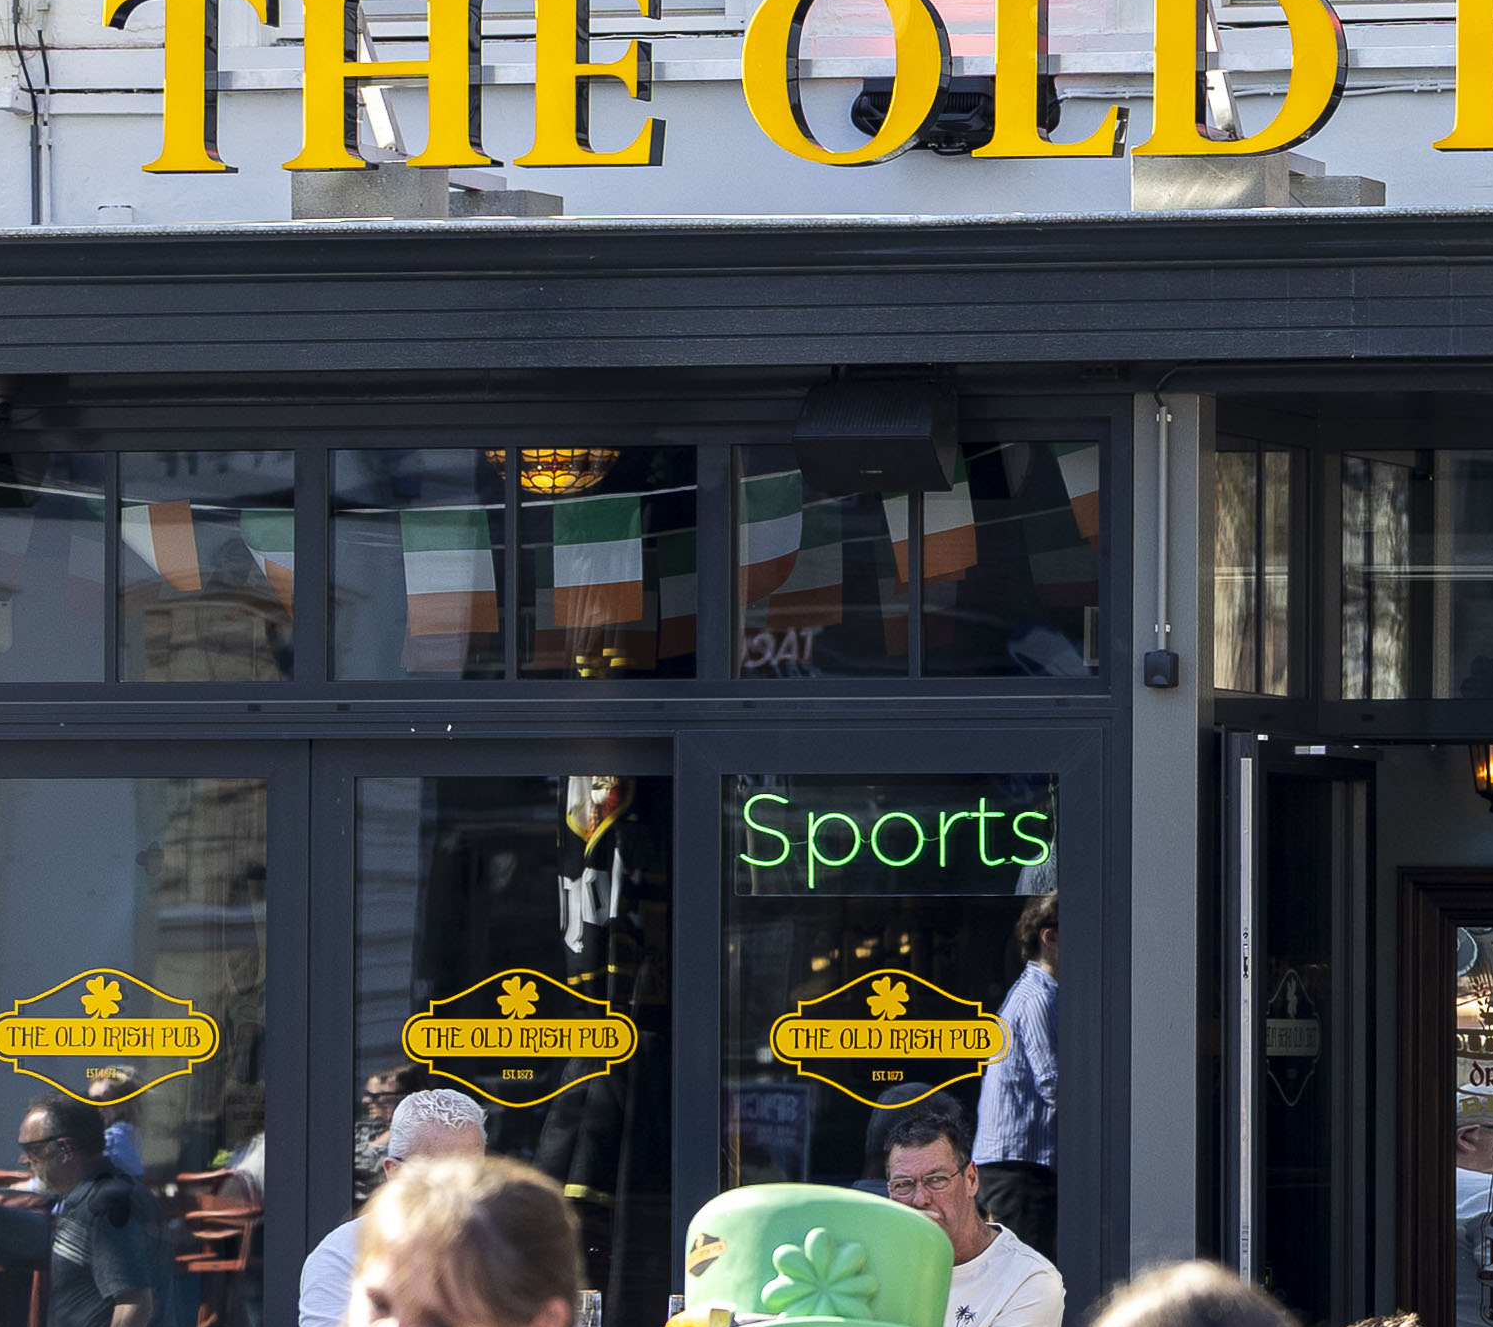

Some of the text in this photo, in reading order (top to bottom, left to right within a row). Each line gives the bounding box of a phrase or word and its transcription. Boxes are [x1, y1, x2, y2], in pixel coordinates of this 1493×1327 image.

[739, 793, 1050, 890] Sports
[7, 1026, 201, 1052] THE OLD IRISH PUB
[421, 1026, 620, 1053] THE OLD IRISH PUB
[788, 1027, 991, 1054] THE OLD IRISH PUB
